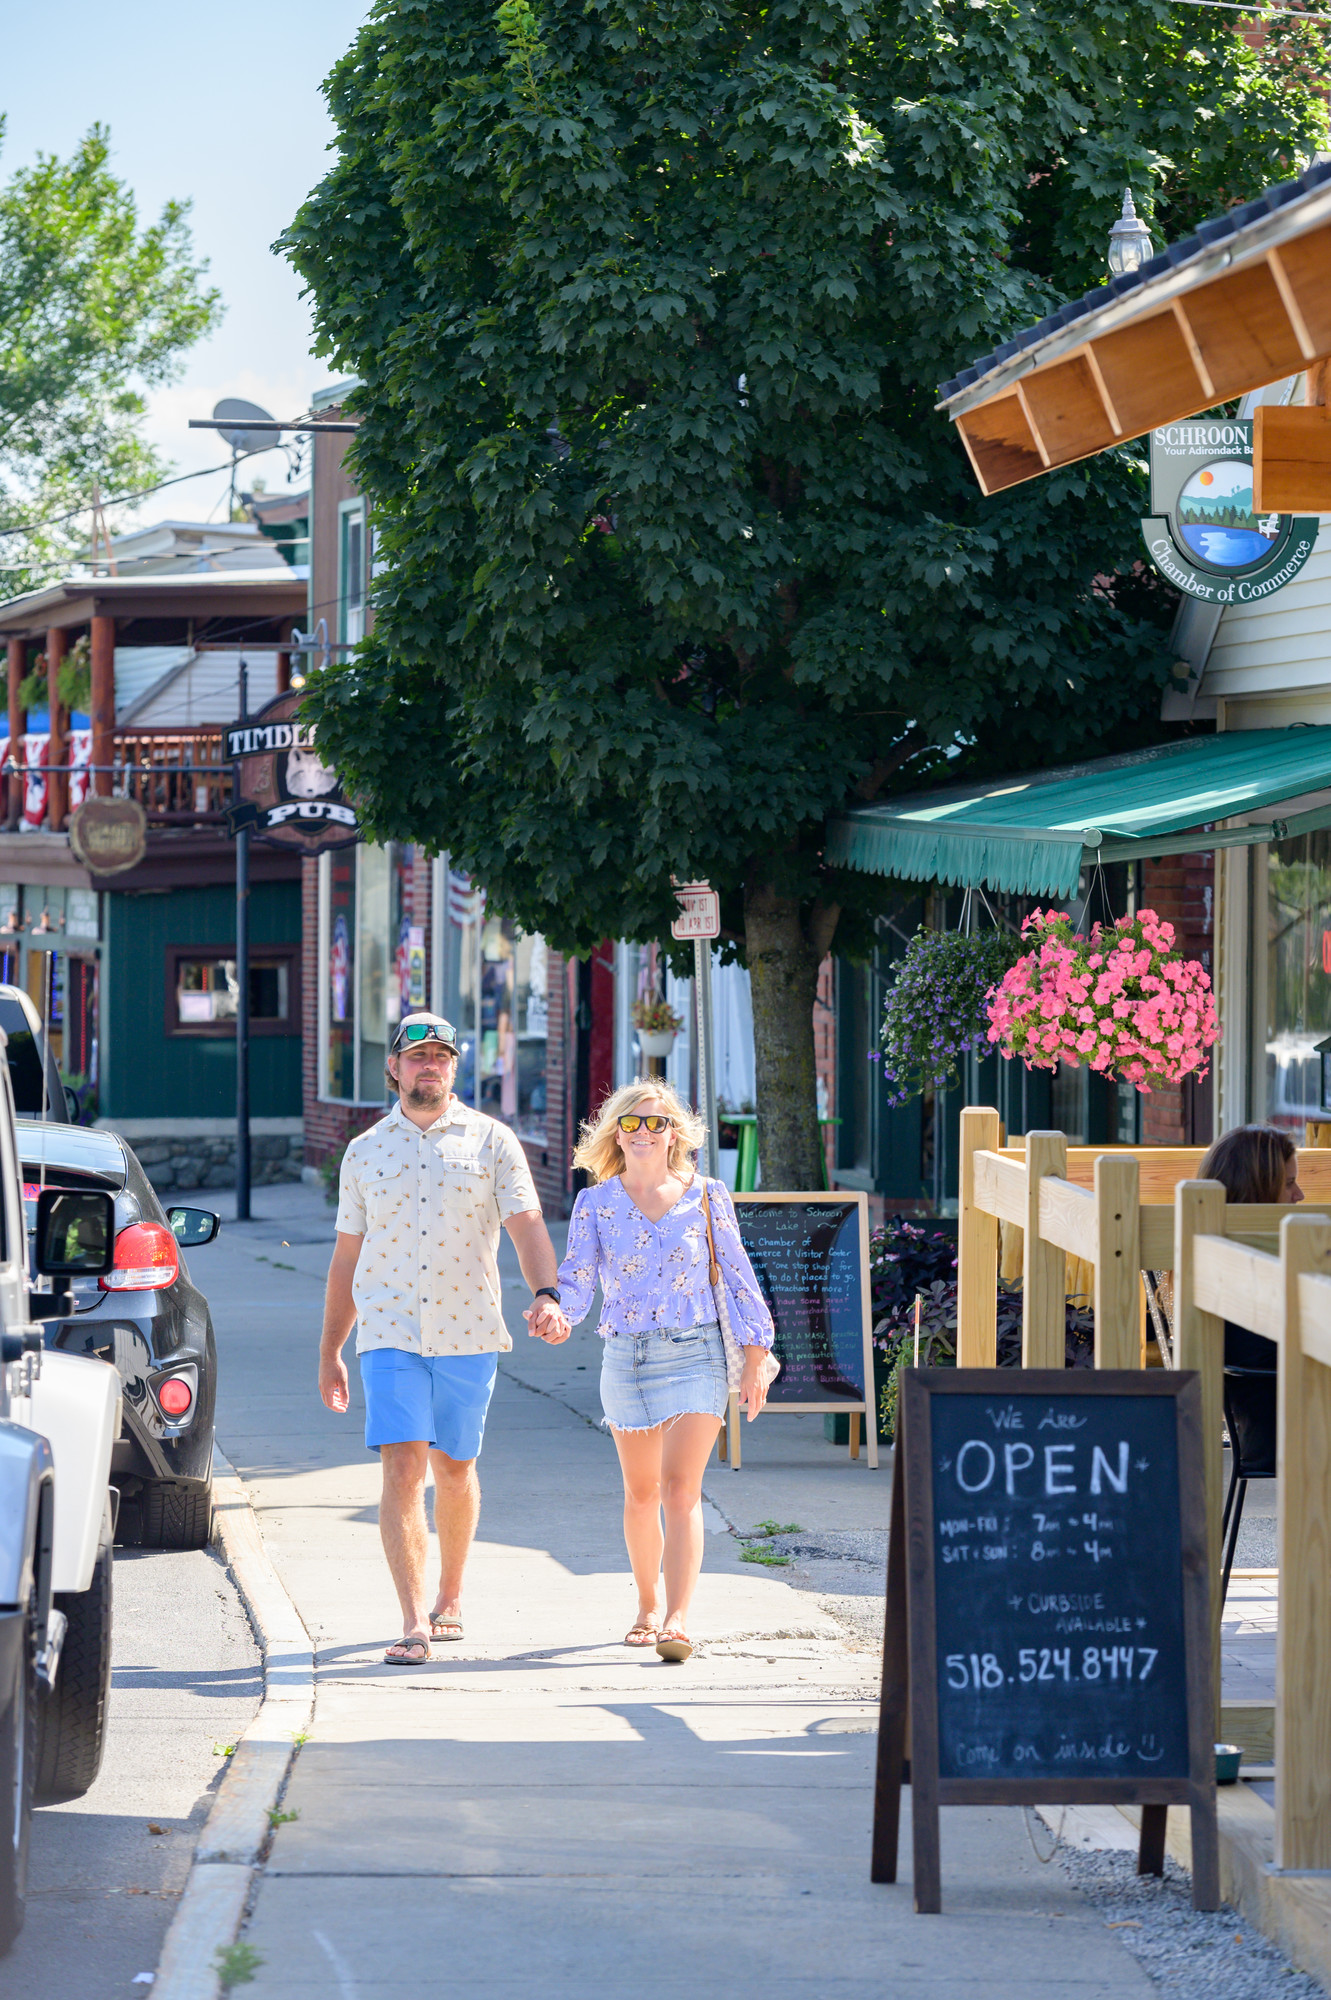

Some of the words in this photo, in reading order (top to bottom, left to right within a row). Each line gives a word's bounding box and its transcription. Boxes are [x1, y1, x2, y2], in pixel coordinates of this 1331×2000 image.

[1155, 426, 1248, 446] SCHROON
[1164, 447, 1186, 456] Your
[1188, 446, 1242, 455] Adirondack
[1244, 446, 1253, 454] Ba
[1152, 540, 1214, 599] Chamber
[1216, 584, 1234, 601] of
[1238, 540, 1311, 600] Commerce
[267, 802, 356, 826] PUB
[740, 1208, 783, 1219] Welcome
[789, 1208, 798, 1218] to
[806, 1206, 843, 1218] Schroon
[740, 1236, 755, 1248] The
[758, 1236, 796, 1247] Chamber
[802, 1236, 812, 1246] of
[748, 1250, 782, 1258] mmerce
[794, 1249, 824, 1258] Visitor
[828, 1247, 852, 1257] Center
[772, 1261, 789, 1270] "one
[792, 1262, 810, 1272] stop
[812, 1262, 834, 1274] shop"
[839, 1260, 852, 1271] for
[768, 1273, 778, 1281] to
[780, 1272, 792, 1281] do
[801, 1273, 828, 1284] places
[831, 1272, 840, 1280] to
[844, 1274, 856, 1283] go,
[770, 1284, 810, 1292] attractions
[777, 1298, 796, 1306] have
[826, 1297, 850, 1308] great
[794, 1307, 840, 1316] merchandise
[796, 1332, 802, 1340] A
[774, 1342, 820, 1350] DISTANCING
[785, 1364, 806, 1372] KEEP
[986, 1405, 1024, 1431] WE
[956, 1440, 1130, 1494] OPEN
[942, 1546, 970, 1564] SAT
[1028, 1592, 1104, 1614] CURBSIDE
[1056, 1616, 1132, 1635] AVAILABLE
[946, 1646, 1158, 1690] 518.524.8447
[1013, 1743, 1041, 1760] on
[1054, 1734, 1130, 1760] inside
